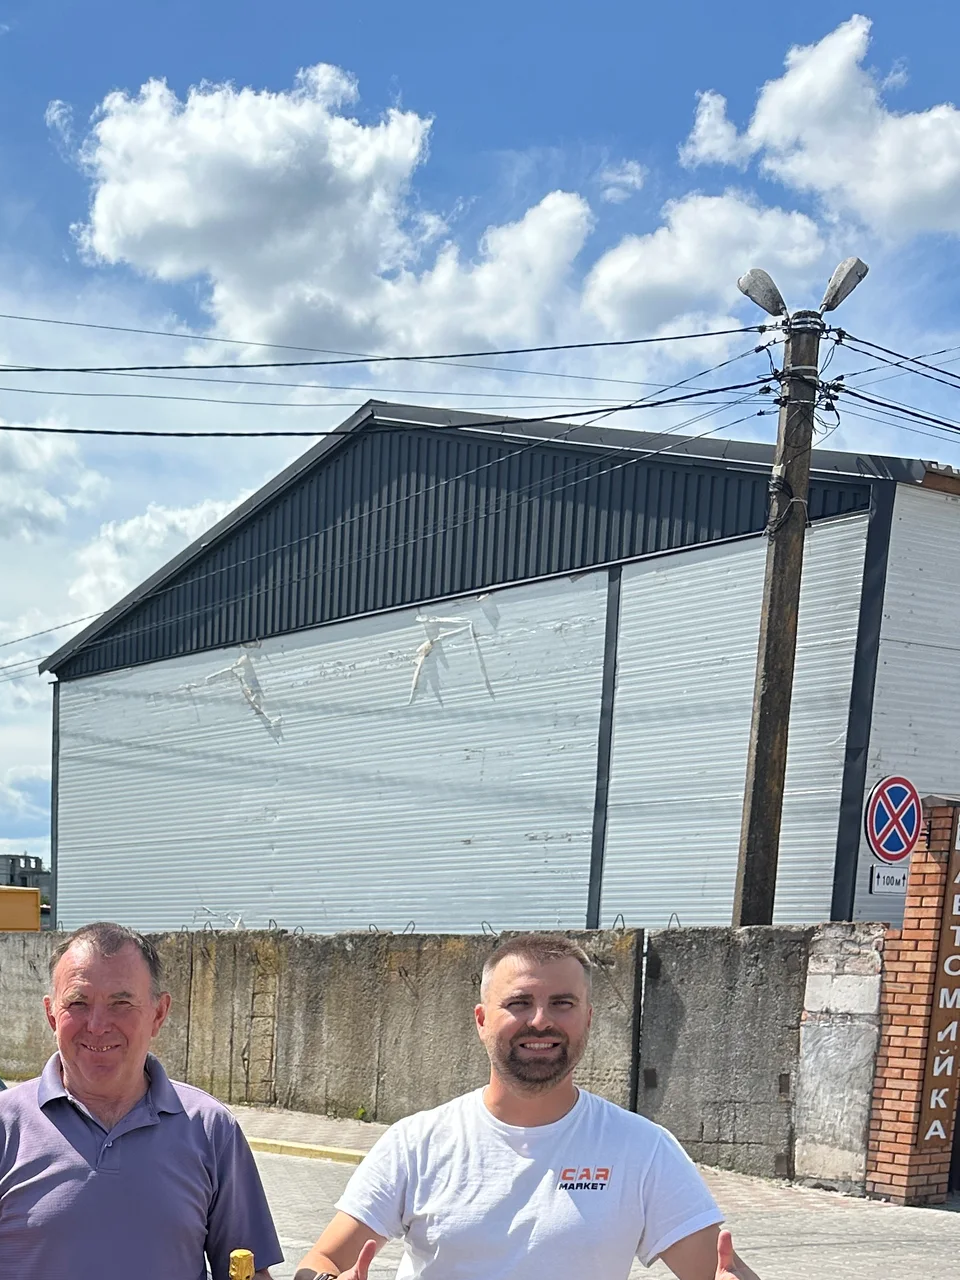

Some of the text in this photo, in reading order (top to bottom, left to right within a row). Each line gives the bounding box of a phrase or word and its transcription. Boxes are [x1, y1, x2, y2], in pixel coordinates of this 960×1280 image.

[924, 870, 960, 1141] ТОМИЙКА
[561, 1167, 610, 1181] CAR
[558, 1182, 607, 1191] MARKET
